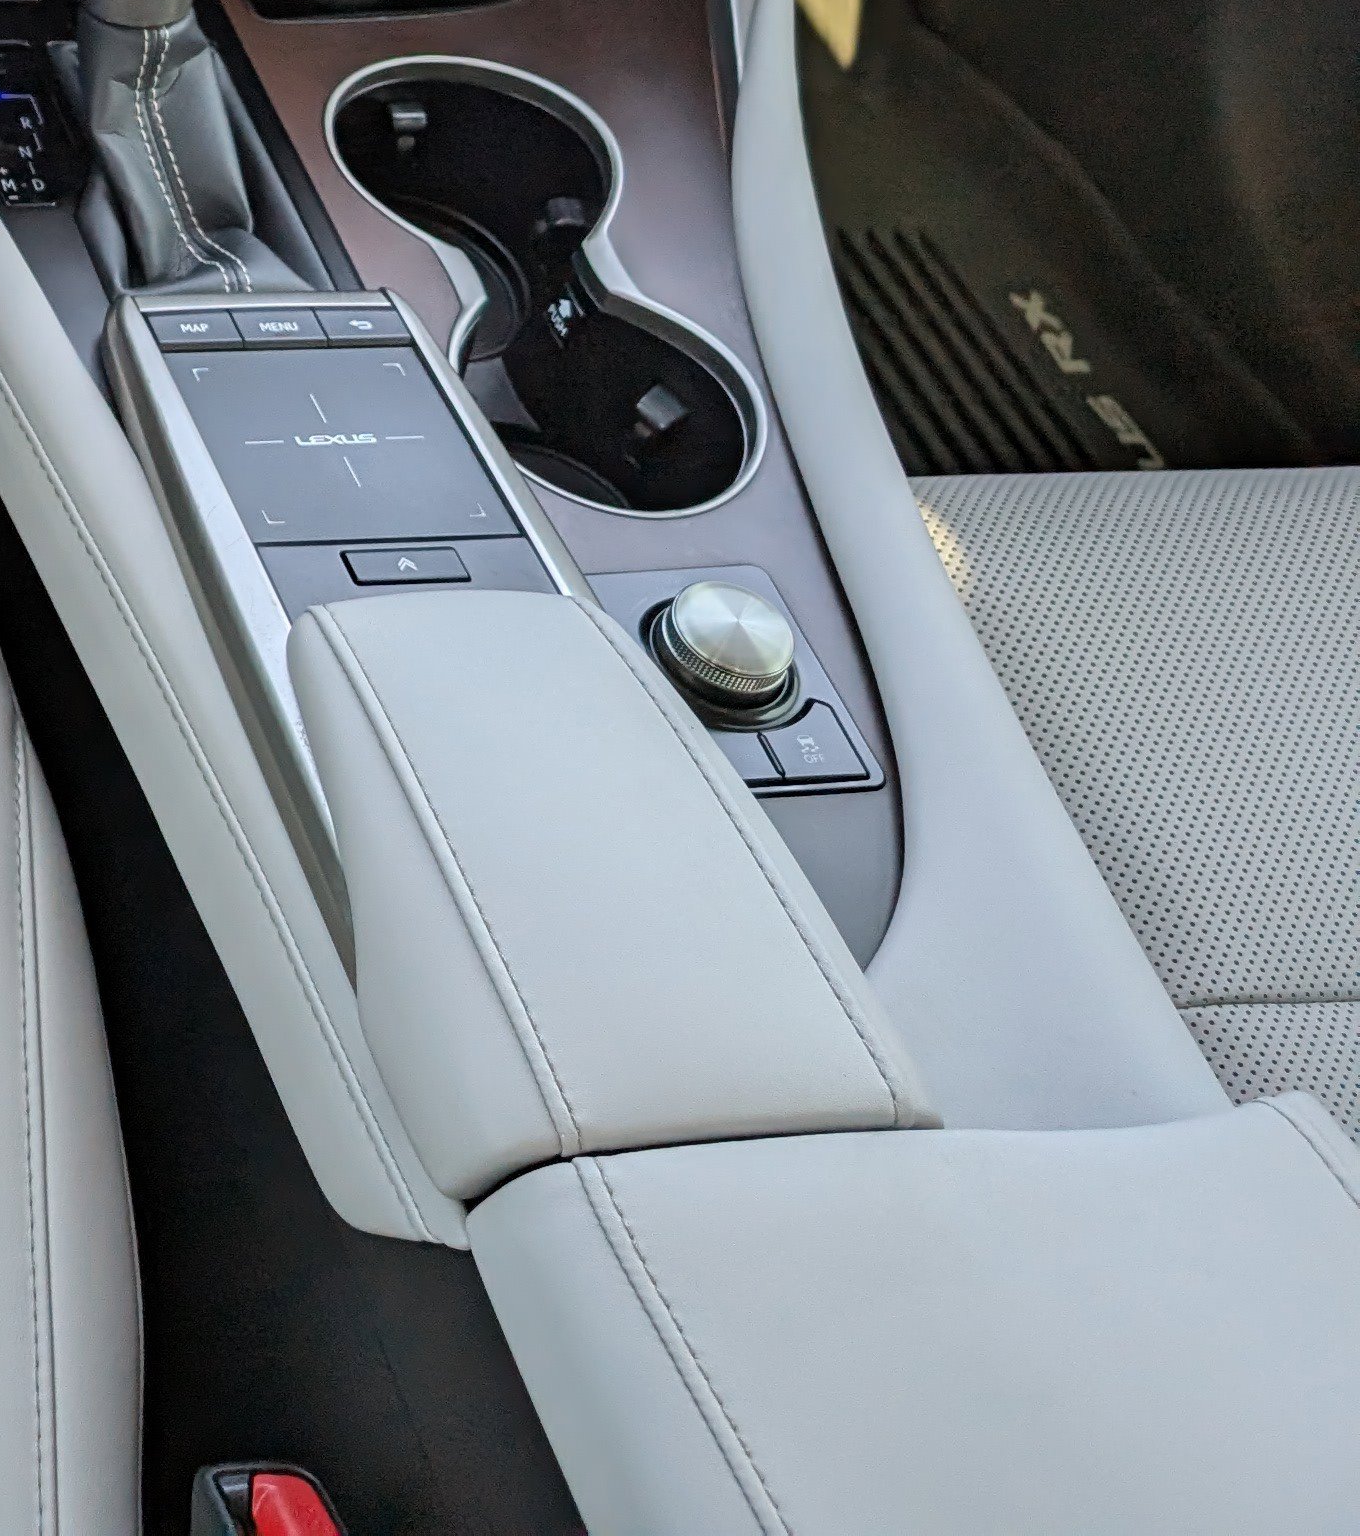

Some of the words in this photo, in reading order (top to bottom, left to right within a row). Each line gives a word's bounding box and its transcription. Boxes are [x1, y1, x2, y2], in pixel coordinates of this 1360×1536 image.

[20, 115, 33, 130] R
[18, 145, 33, 159] N
[0, 178, 18, 193] M
[31, 177, 45, 192] D
[180, 322, 209, 334] MAP
[259, 321, 299, 333] MENU
[294, 433, 379, 447] LEXUS
[803, 753, 825, 765] OFF
